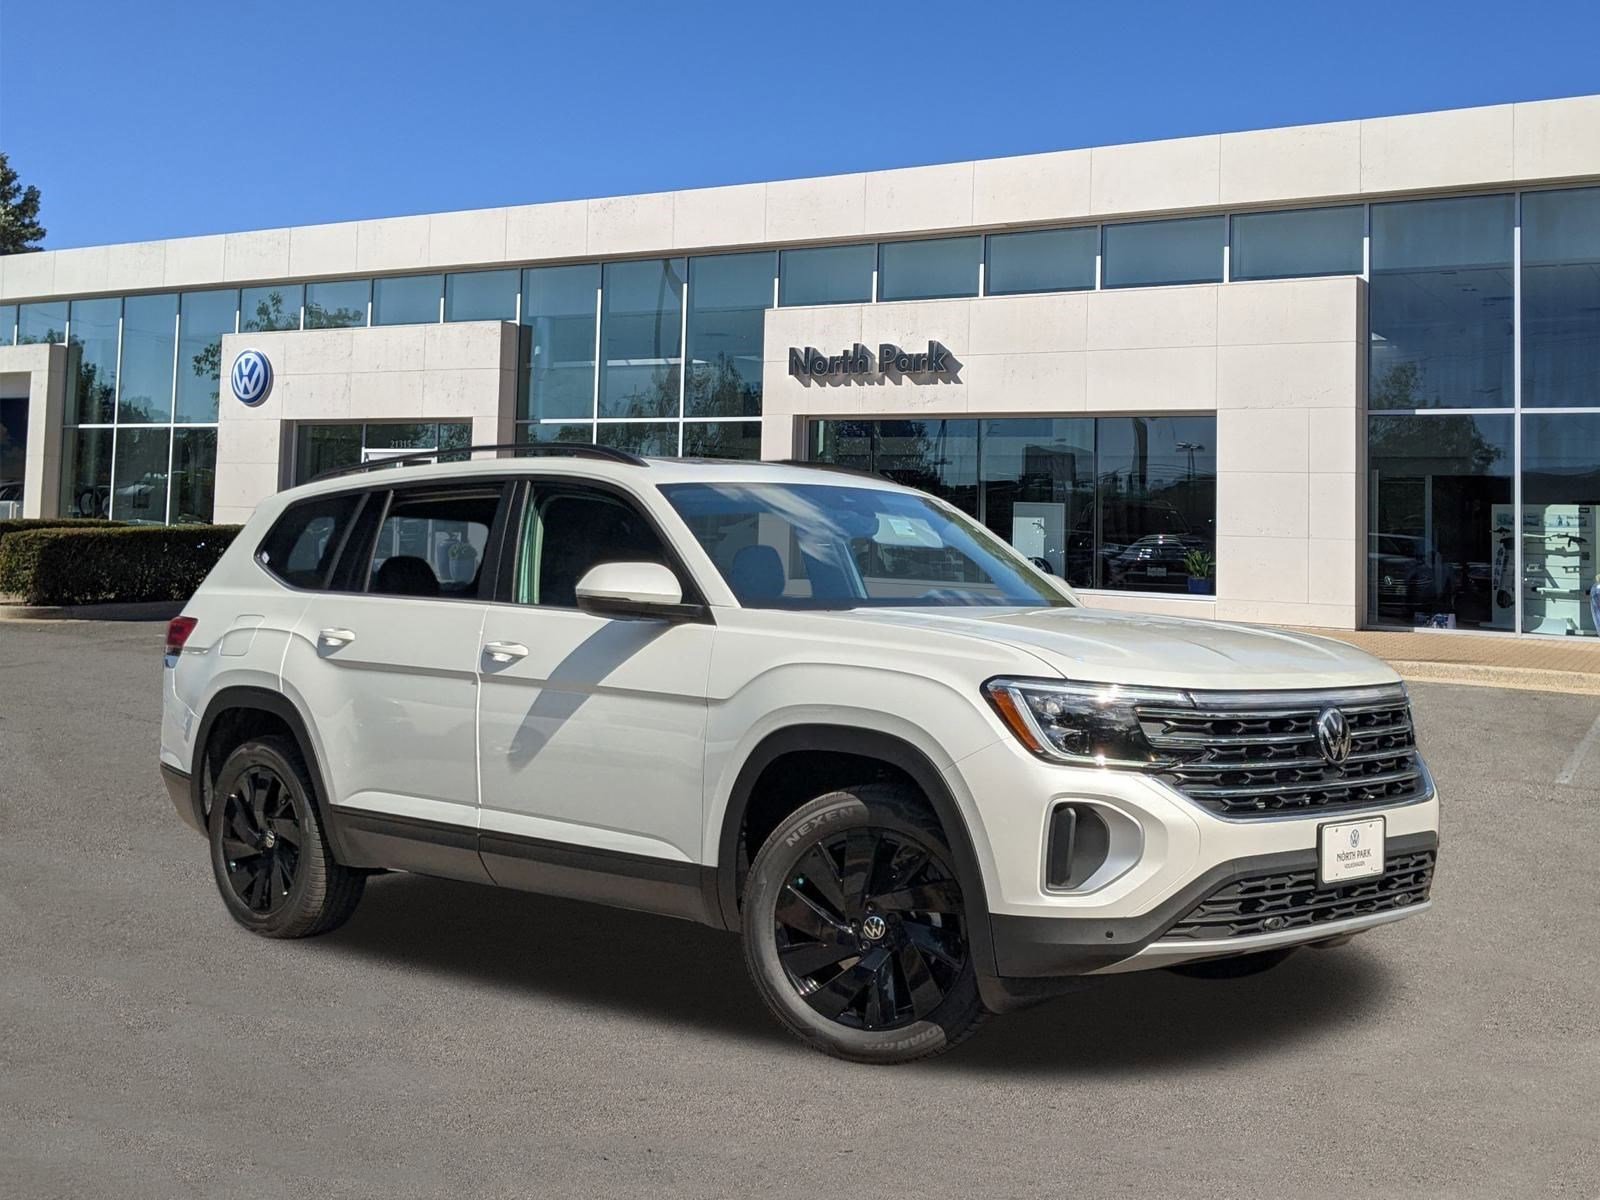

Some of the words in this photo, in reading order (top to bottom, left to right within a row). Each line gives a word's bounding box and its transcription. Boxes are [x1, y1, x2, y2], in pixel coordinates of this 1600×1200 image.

[788, 342, 873, 376] North
[878, 340, 948, 373] Park
[785, 807, 855, 847] NEXEN
[1336, 850, 1356, 862] NORTH
[1356, 848, 1372, 859] PARK
